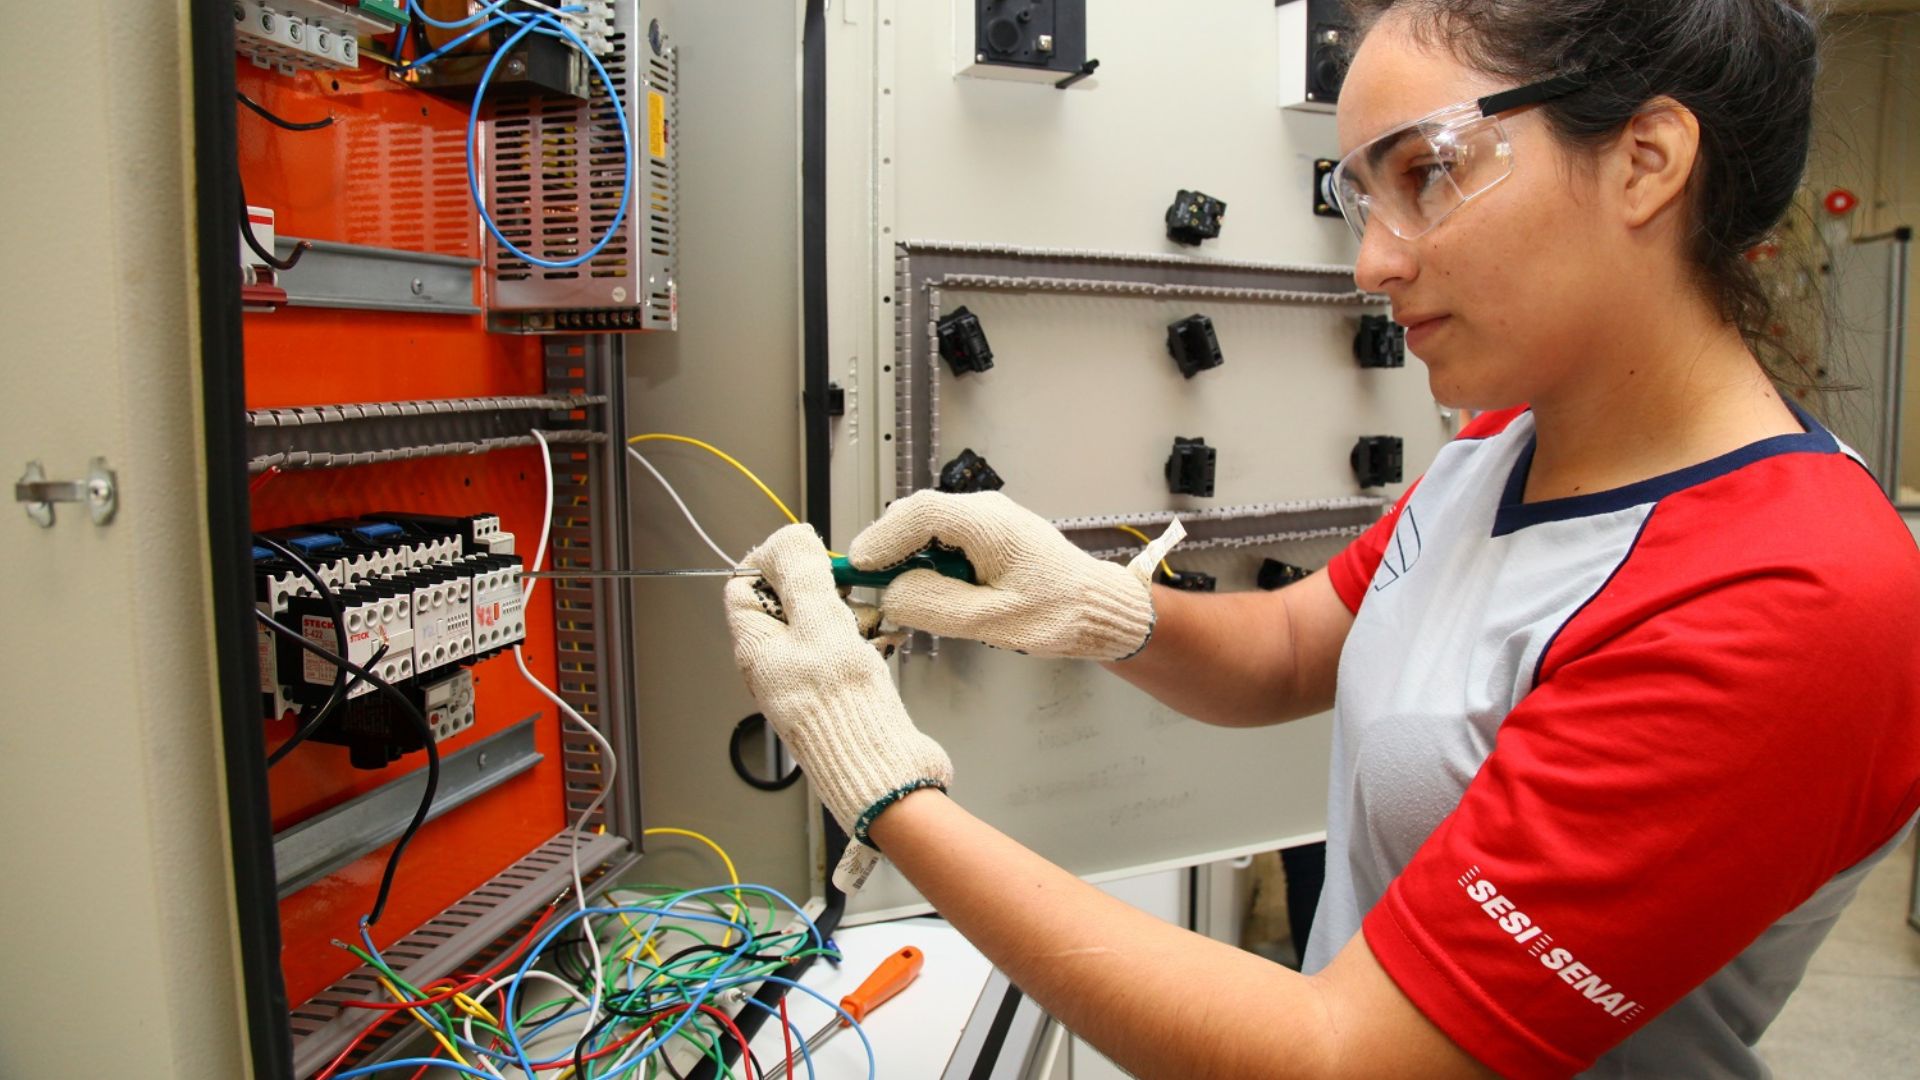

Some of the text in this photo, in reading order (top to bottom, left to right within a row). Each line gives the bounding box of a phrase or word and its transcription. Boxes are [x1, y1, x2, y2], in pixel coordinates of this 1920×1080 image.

[350, 632, 369, 643] STECK
[1466, 879, 1636, 1018] SESI SENAI
